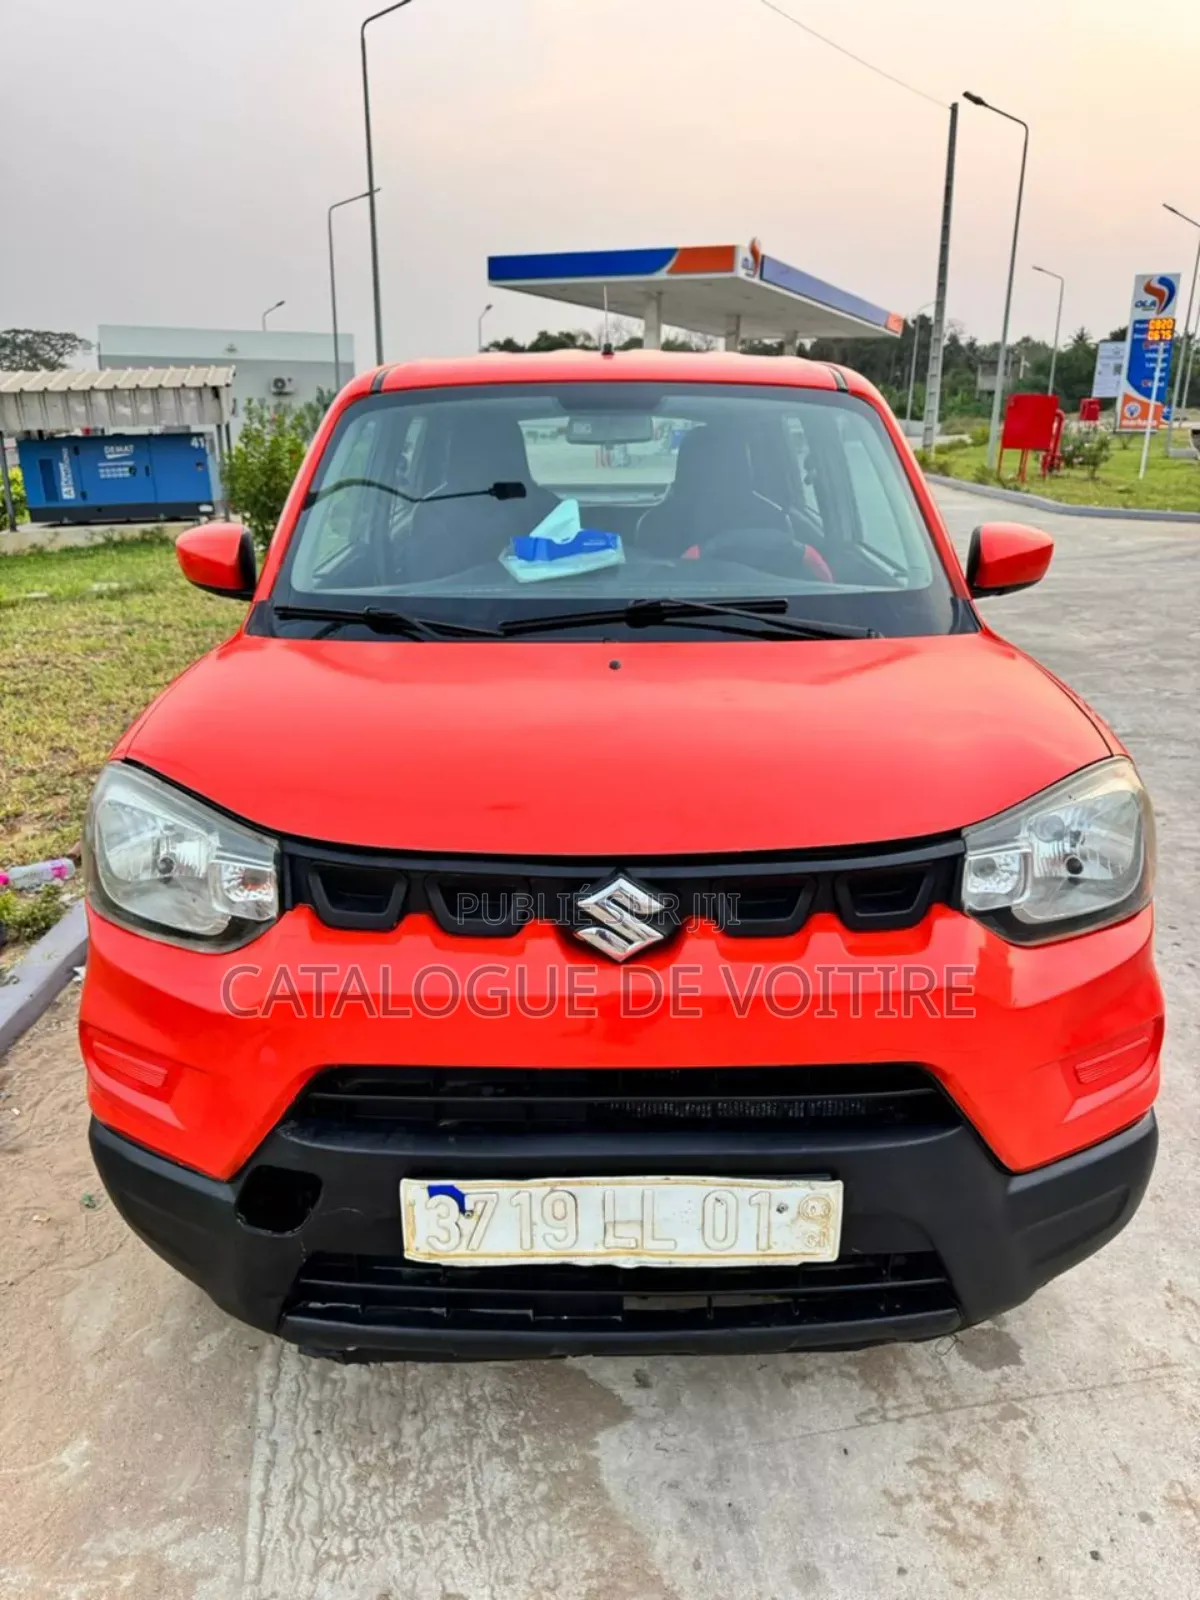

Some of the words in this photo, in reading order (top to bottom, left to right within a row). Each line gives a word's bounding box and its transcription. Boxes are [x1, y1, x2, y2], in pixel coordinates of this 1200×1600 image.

[424, 1189, 579, 1252] 3719
[603, 1189, 677, 1250] LL
[702, 1190, 772, 1251] 01
